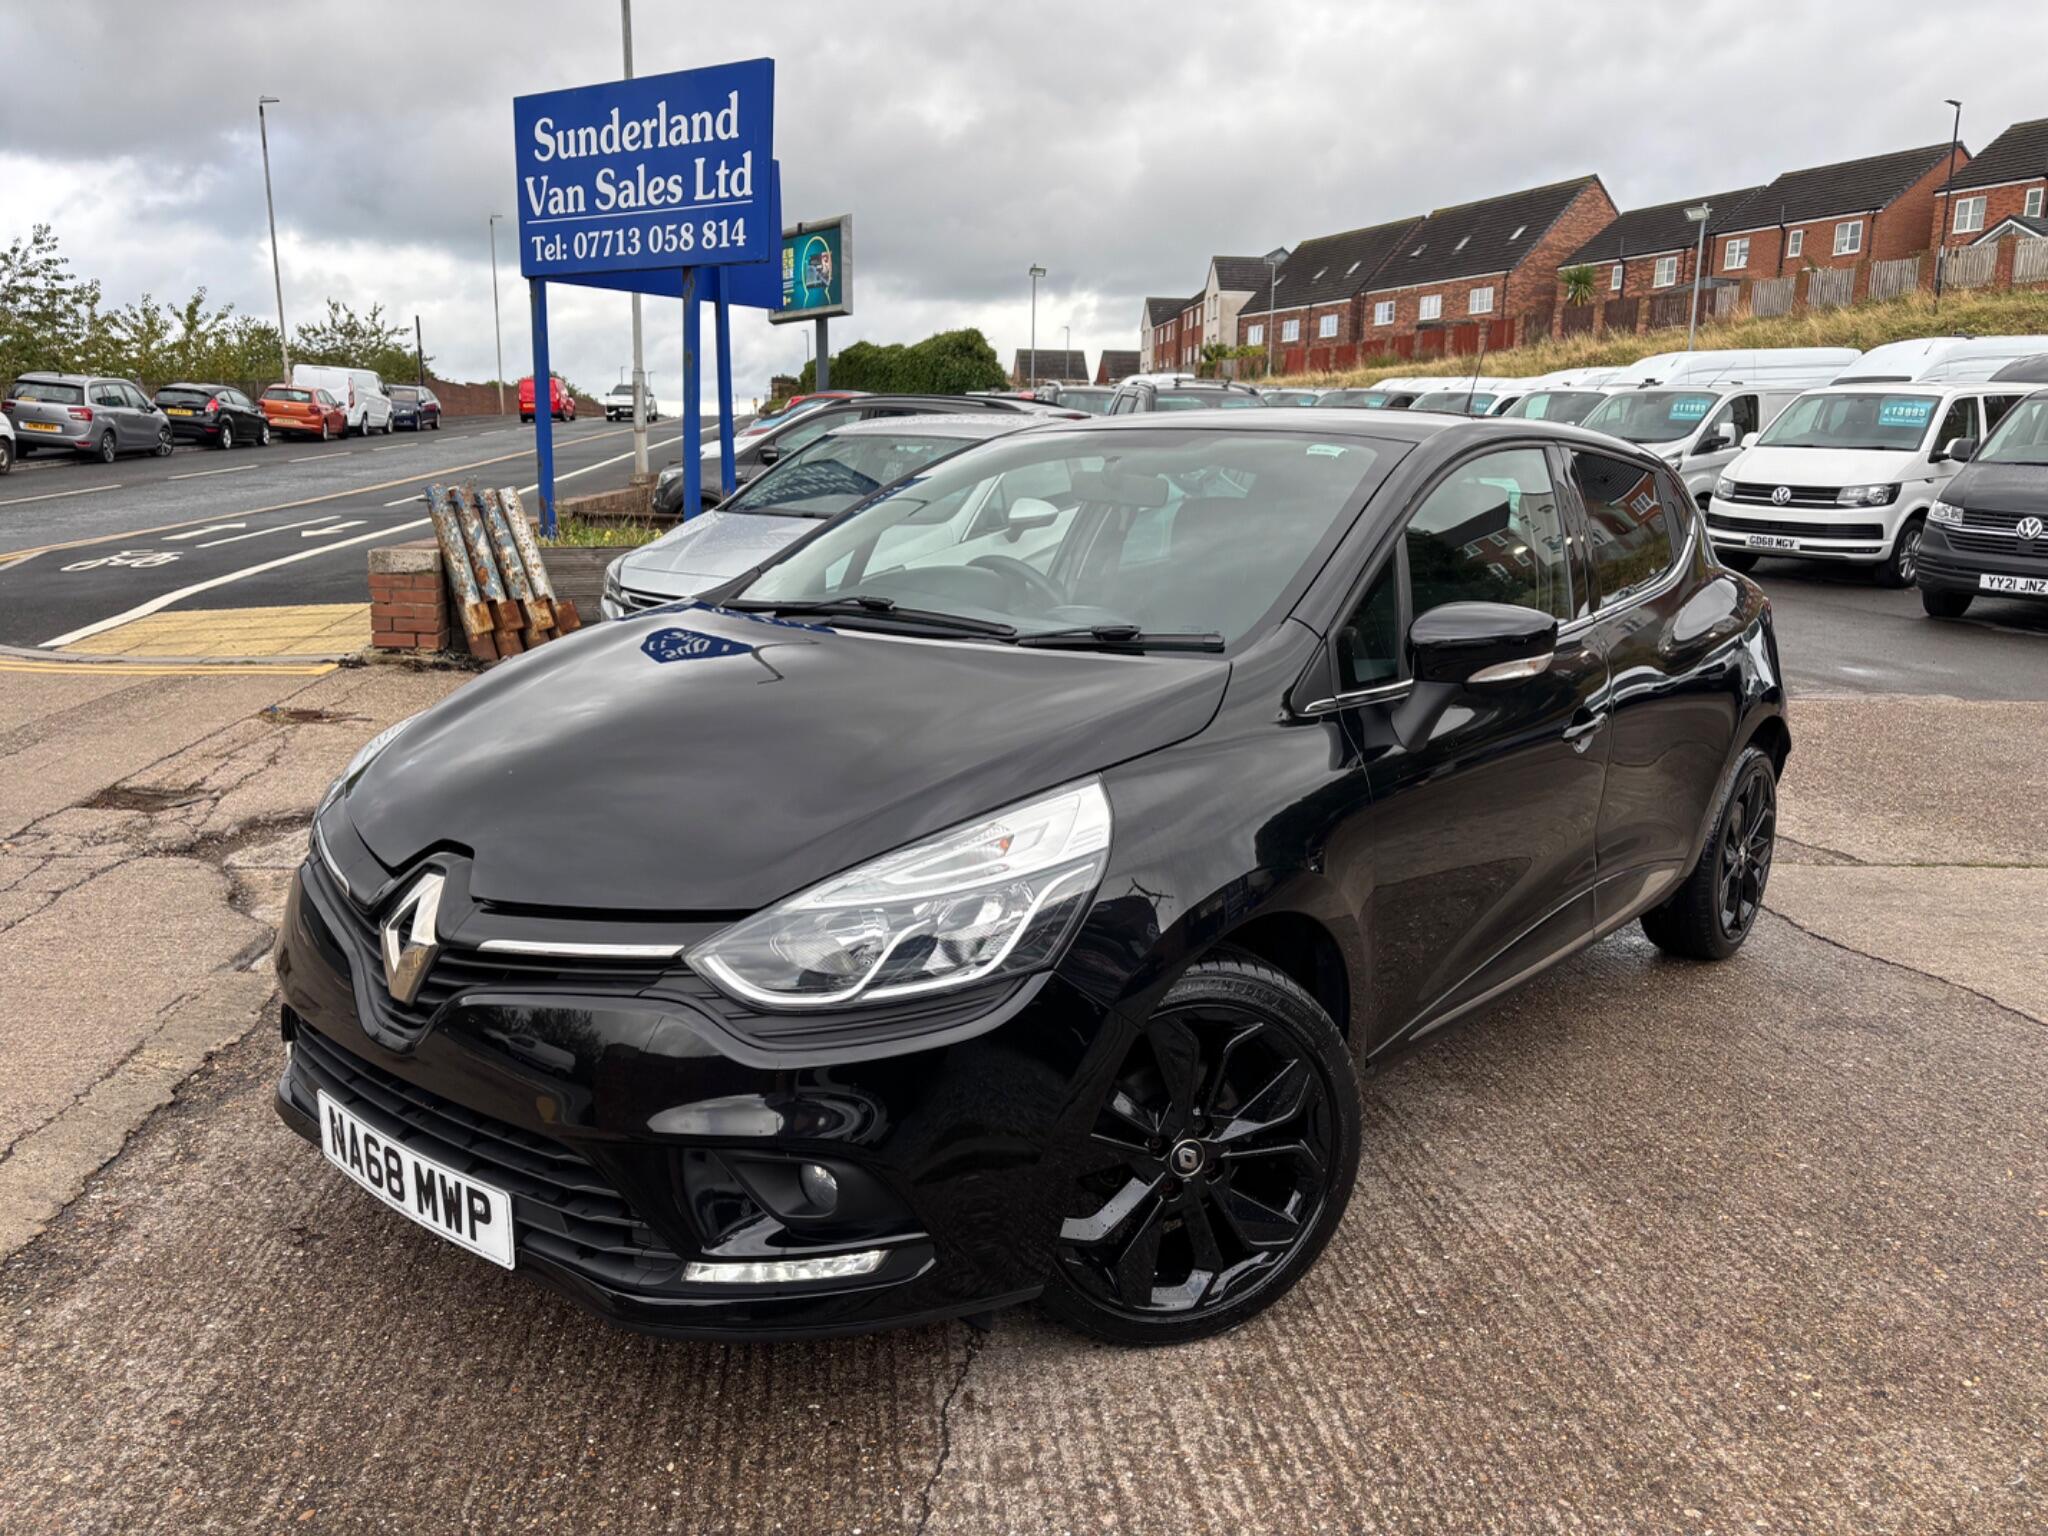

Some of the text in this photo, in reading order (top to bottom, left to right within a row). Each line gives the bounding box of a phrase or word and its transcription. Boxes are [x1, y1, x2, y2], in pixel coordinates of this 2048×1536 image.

[534, 90, 740, 162] Sunderland
[525, 151, 753, 217] Van Sales Ltd
[532, 217, 747, 262] Tel: 07713 058 814
[1988, 575, 2047, 592] YY21 JNZ
[328, 1105, 492, 1242] NA68 MWP
